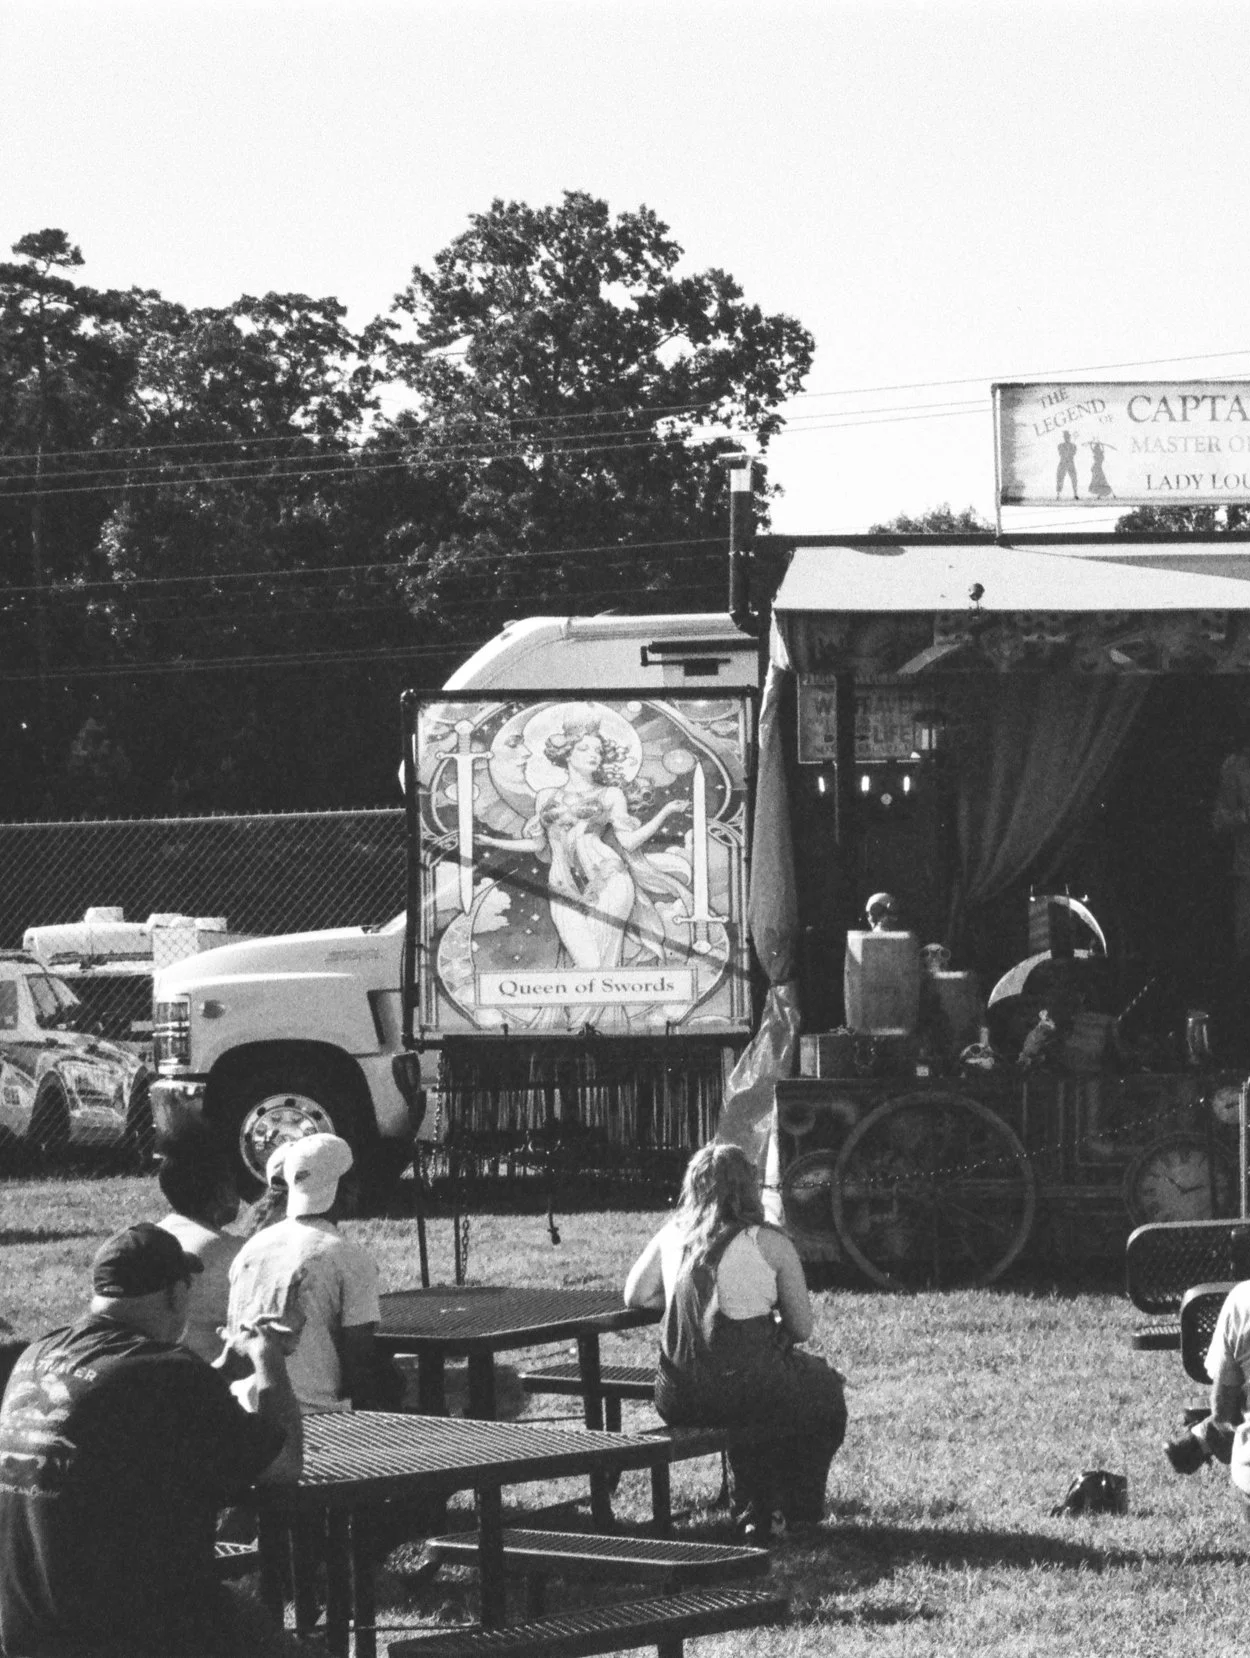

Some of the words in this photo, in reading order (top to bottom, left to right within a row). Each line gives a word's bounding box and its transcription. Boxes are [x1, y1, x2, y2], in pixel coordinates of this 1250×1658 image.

[1040, 387, 1069, 408] THE
[1032, 399, 1106, 437] LEGEND
[1130, 435, 1222, 454] MASTER
[1145, 473, 1204, 492] LADY
[498, 979, 567, 998] Queen
[575, 978, 595, 994] of
[601, 976, 675, 994] Swords
